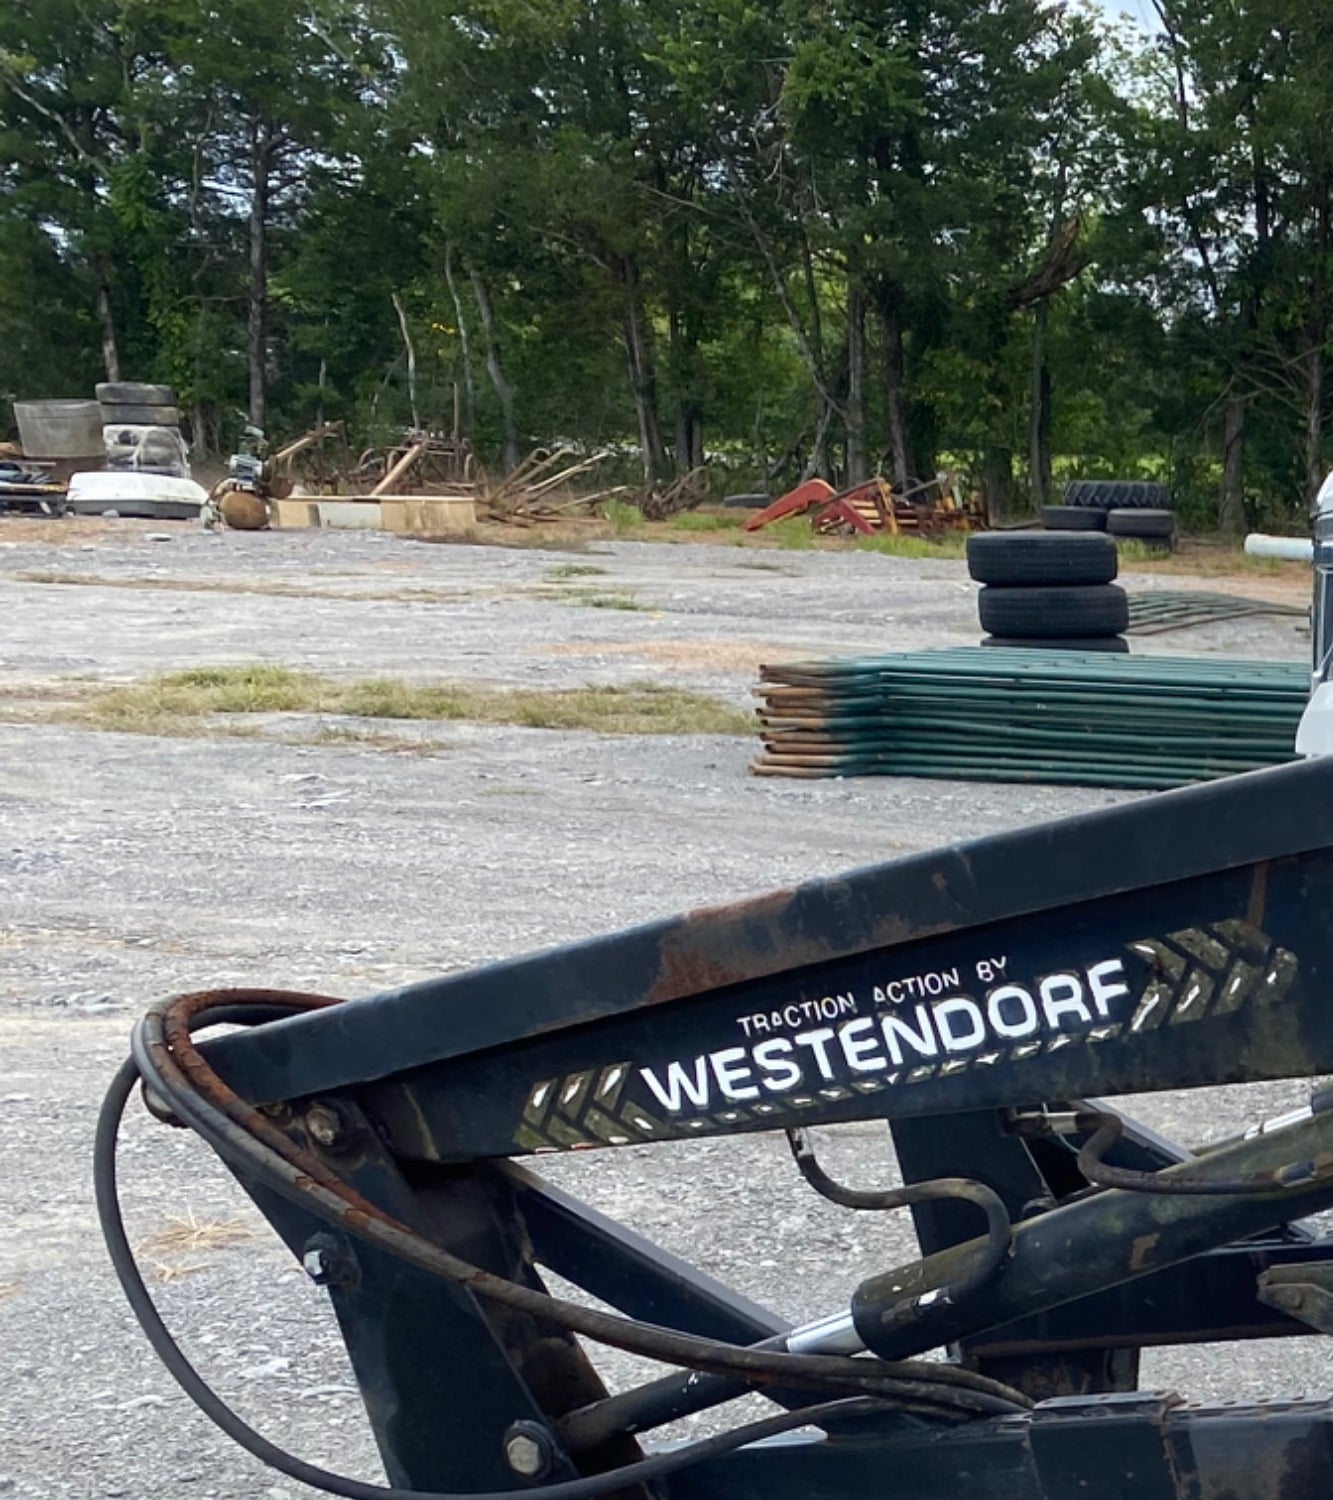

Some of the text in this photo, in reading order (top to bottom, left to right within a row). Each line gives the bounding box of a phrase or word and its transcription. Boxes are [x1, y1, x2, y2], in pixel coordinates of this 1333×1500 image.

[640, 958, 1130, 1112] WESTENDORF
[736, 955, 1008, 1037] TRACTION ACTION BY
